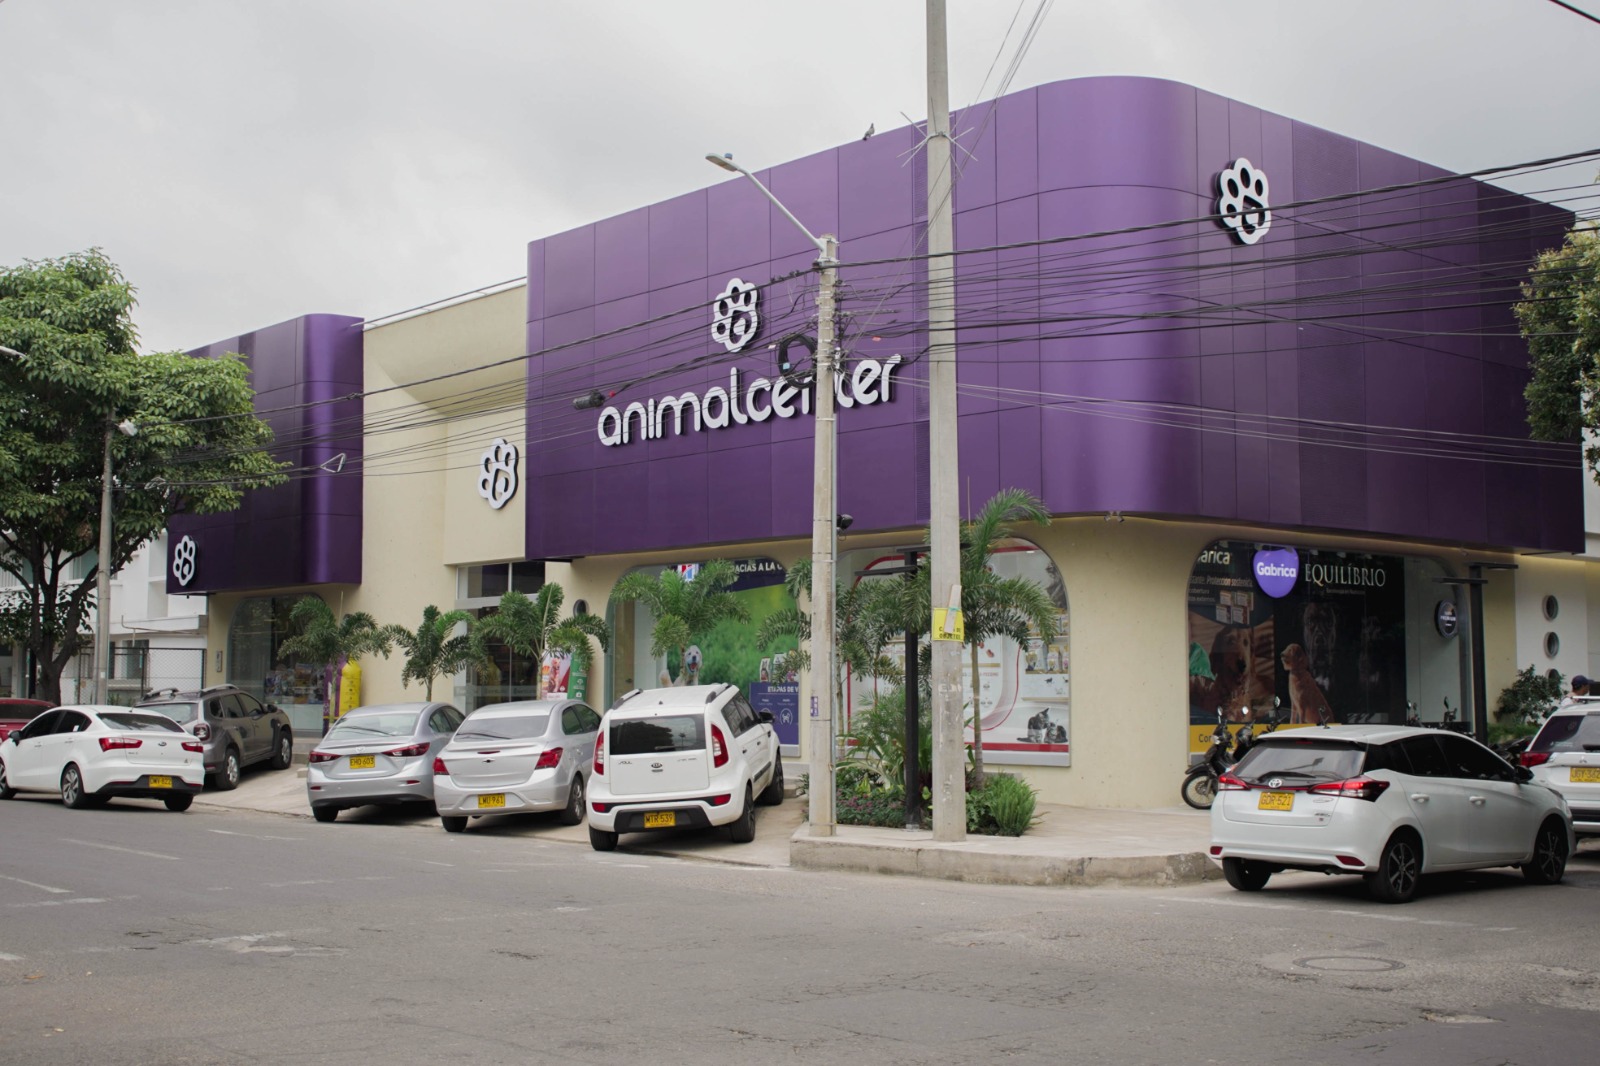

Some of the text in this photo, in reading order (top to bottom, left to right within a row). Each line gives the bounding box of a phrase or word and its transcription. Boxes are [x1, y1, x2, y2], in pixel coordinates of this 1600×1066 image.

[1199, 546, 1230, 565] arica
[1256, 562, 1297, 578] Gabrica
[1305, 563, 1386, 587] EQUILÍBRIO
